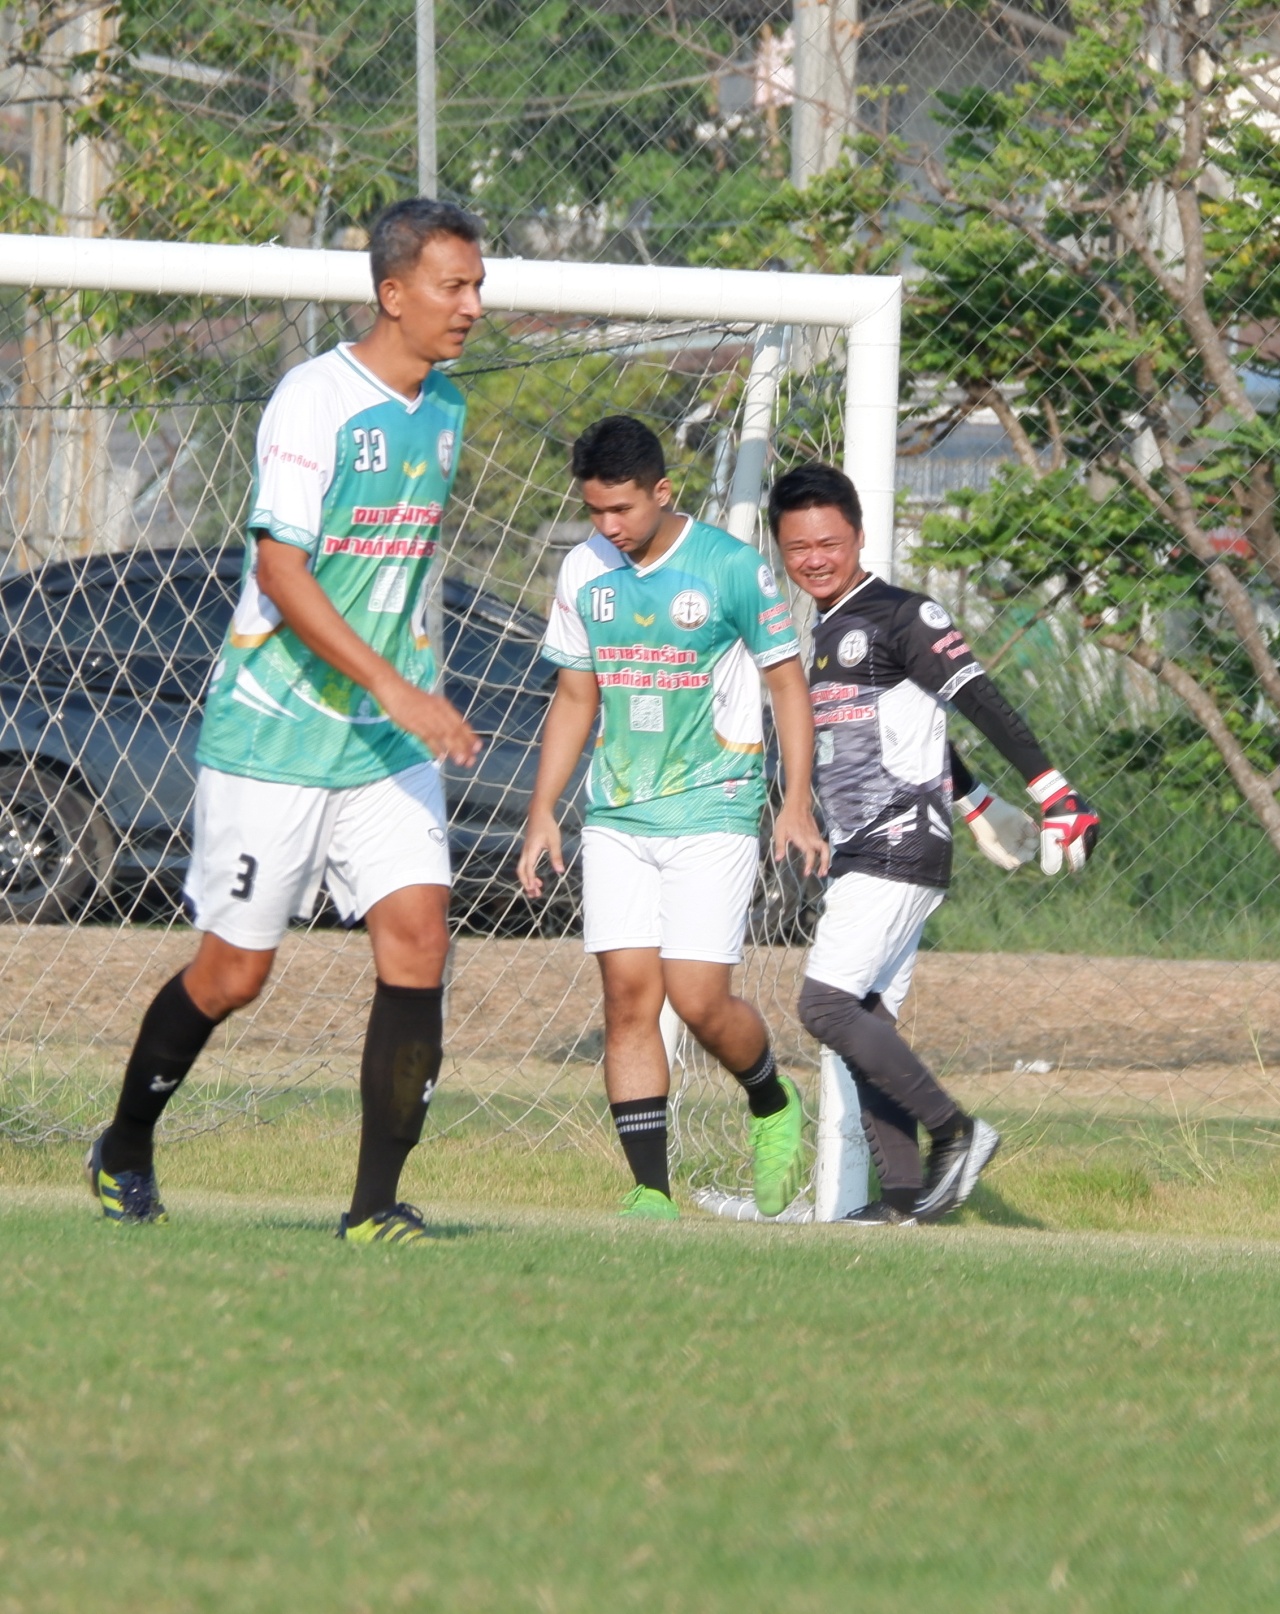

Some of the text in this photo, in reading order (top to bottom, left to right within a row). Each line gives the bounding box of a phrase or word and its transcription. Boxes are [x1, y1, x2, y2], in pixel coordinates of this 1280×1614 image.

[352, 427, 388, 474] 33
[590, 586, 616, 623] 16
[231, 853, 258, 902] 3
